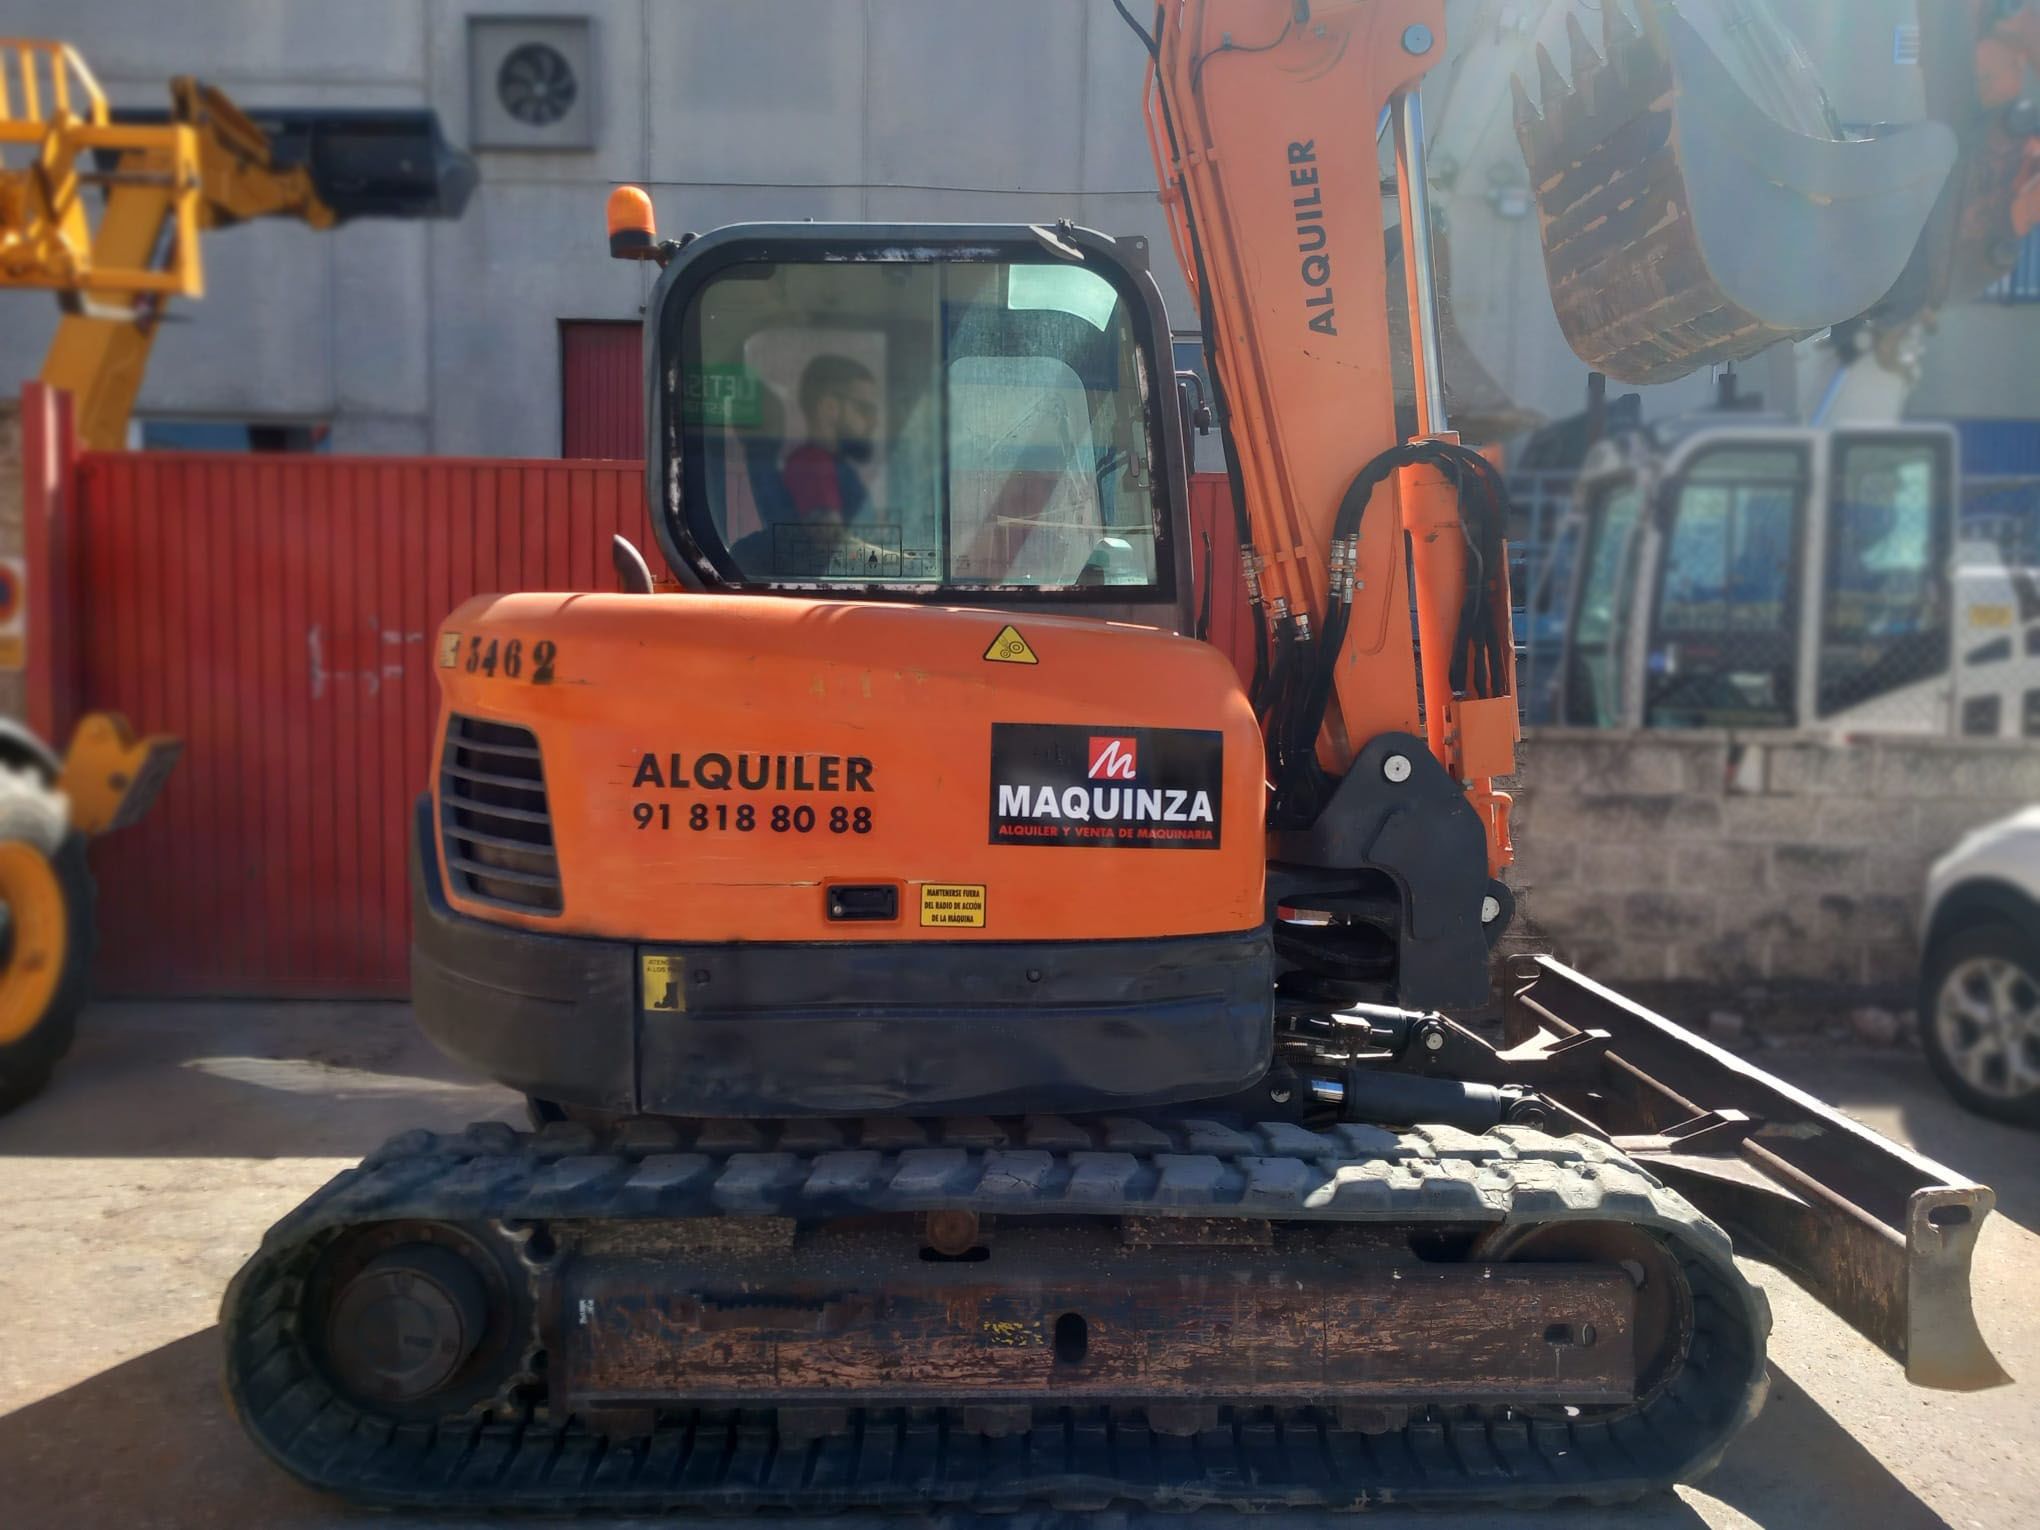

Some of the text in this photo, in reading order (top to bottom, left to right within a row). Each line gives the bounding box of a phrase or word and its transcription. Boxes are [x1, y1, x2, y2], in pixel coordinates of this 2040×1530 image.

[1287, 139, 1338, 336] ALQUILER
[632, 752, 875, 792] ALQUILER
[998, 784, 1214, 822] MAQUINZA
[633, 802, 873, 834] 91 818 80 88
[999, 824, 1213, 840] ALQUILER Y VENTA DE MAQUINARIA
[924, 901, 934, 909] DEL
[935, 901, 952, 909] RADIO
[963, 889, 980, 897] FUERA
[931, 914, 939, 922] DE
[940, 914, 946, 922] LA
